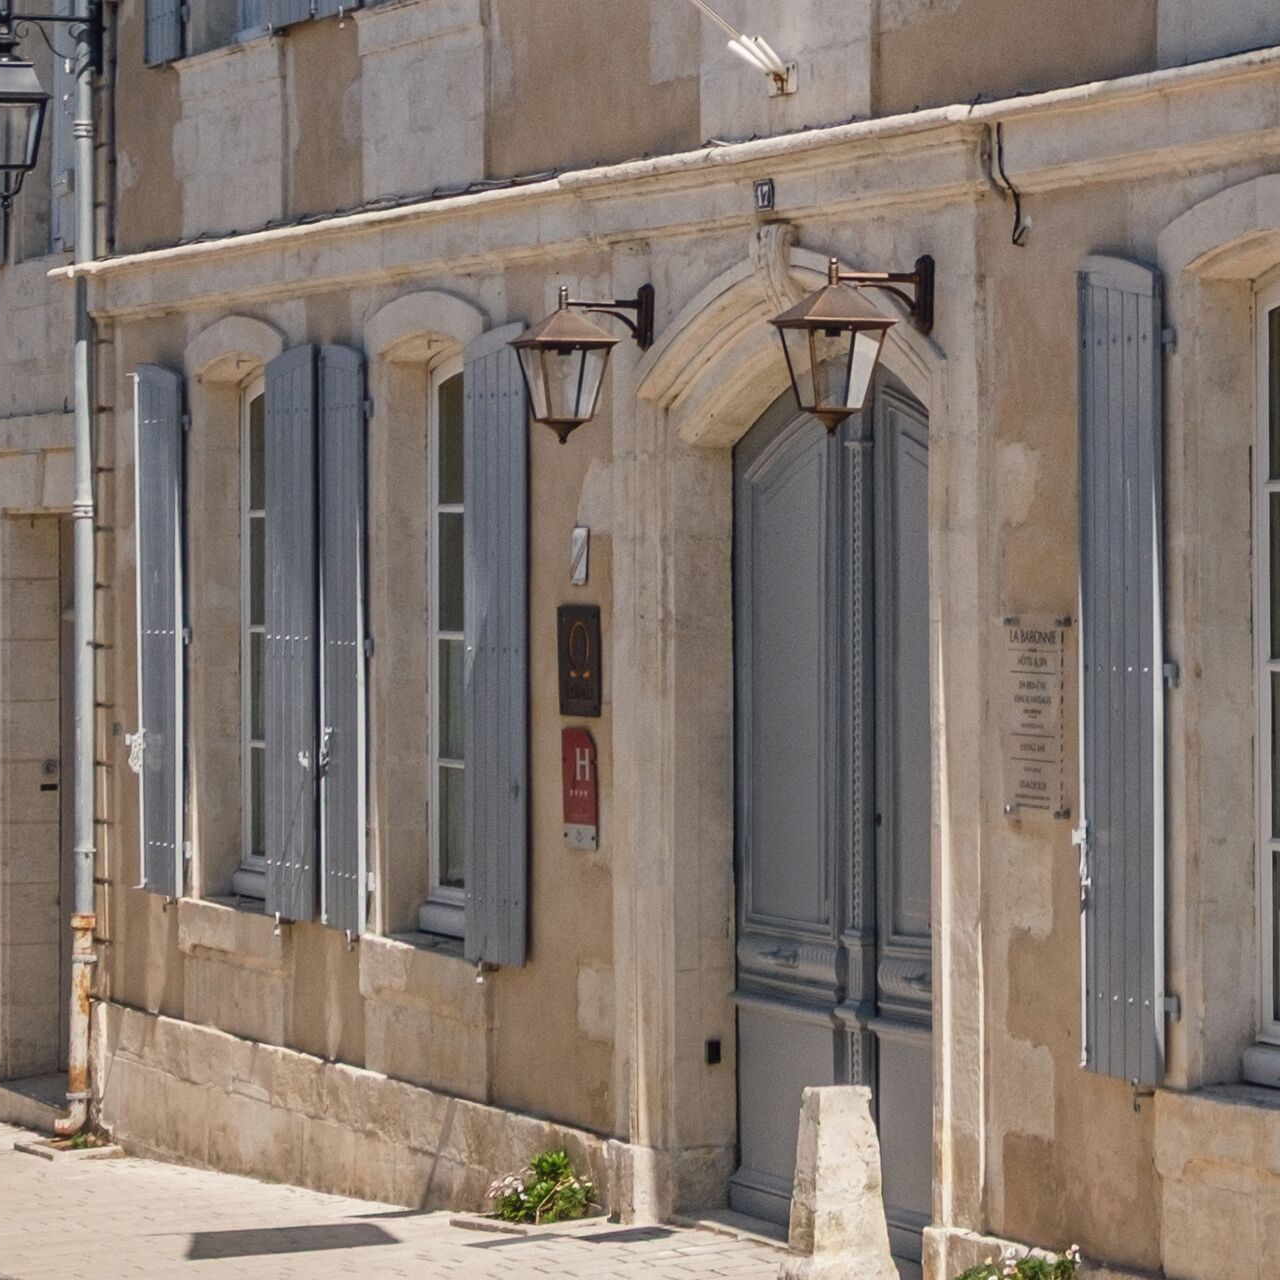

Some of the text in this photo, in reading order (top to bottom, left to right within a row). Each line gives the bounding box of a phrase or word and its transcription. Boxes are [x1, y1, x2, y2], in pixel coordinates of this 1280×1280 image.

[757, 184, 770, 207] 17
[1009, 628, 1019, 643] LA
[575, 747, 590, 781] H
